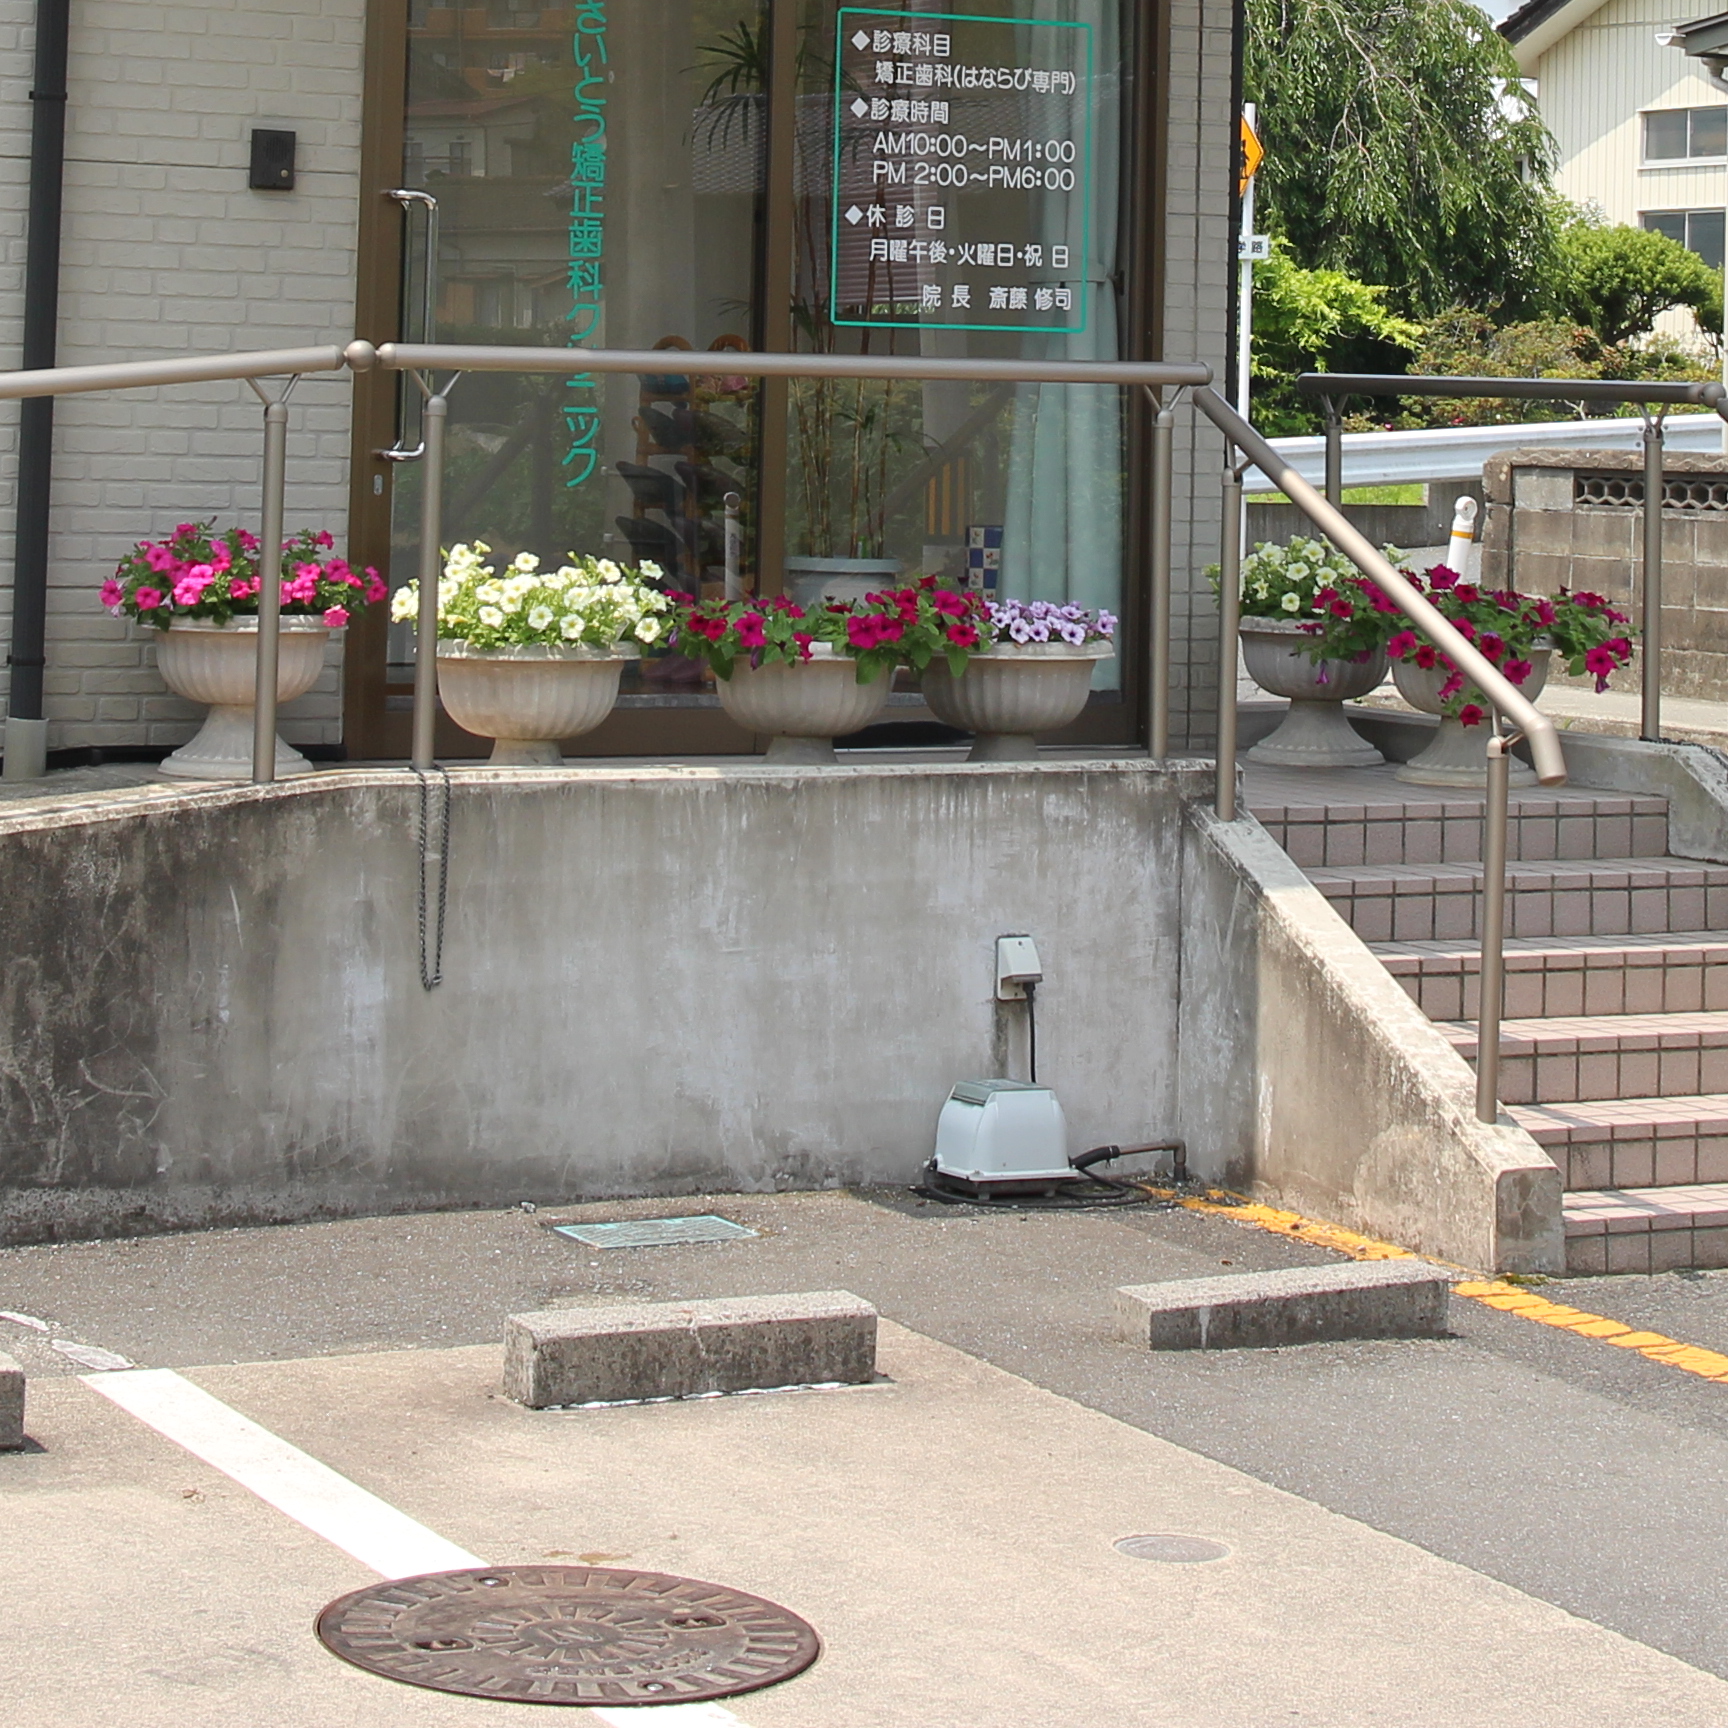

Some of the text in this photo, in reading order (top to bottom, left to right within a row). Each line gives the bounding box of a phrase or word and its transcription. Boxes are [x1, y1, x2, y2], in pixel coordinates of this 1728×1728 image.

[872, 29, 951, 58] 診療科目
[870, 97, 949, 124] 診療時間
